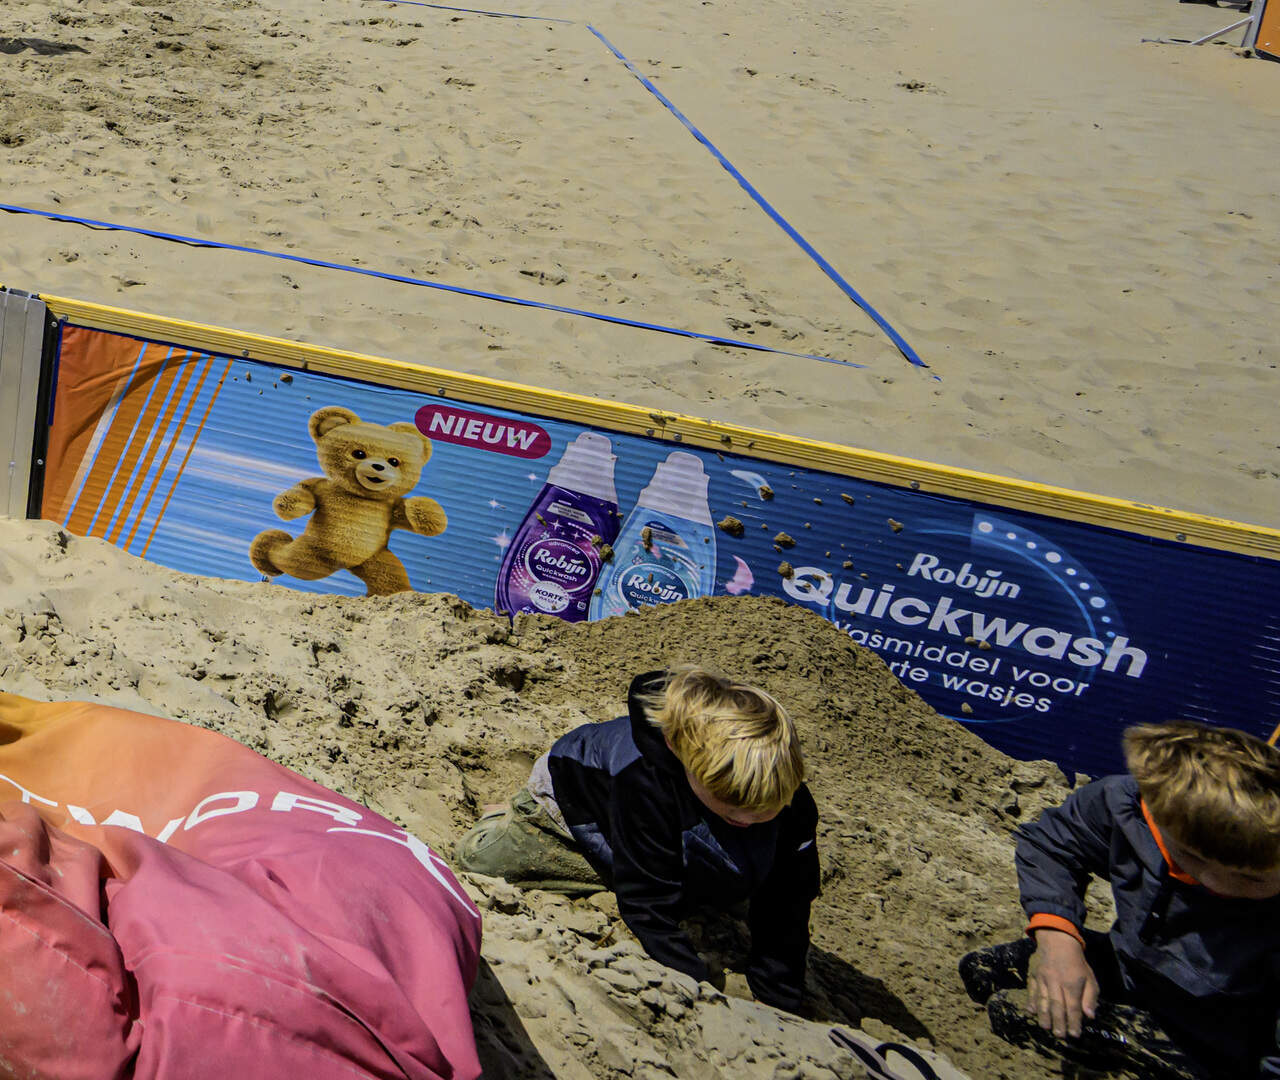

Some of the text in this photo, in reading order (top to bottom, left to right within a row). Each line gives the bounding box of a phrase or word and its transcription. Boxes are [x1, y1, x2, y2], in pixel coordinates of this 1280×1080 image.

[428, 412, 540, 451] NIEUW
[534, 548, 587, 576] Robijn
[535, 564, 578, 582] Quickwash
[907, 552, 1021, 600] Robijn
[535, 588, 564, 602] KORTE
[627, 574, 683, 601] Robijn
[782, 566, 1148, 679] Quickwash
[889, 660, 1052, 714] rte wasjes
[1012, 666, 1089, 698] voor
